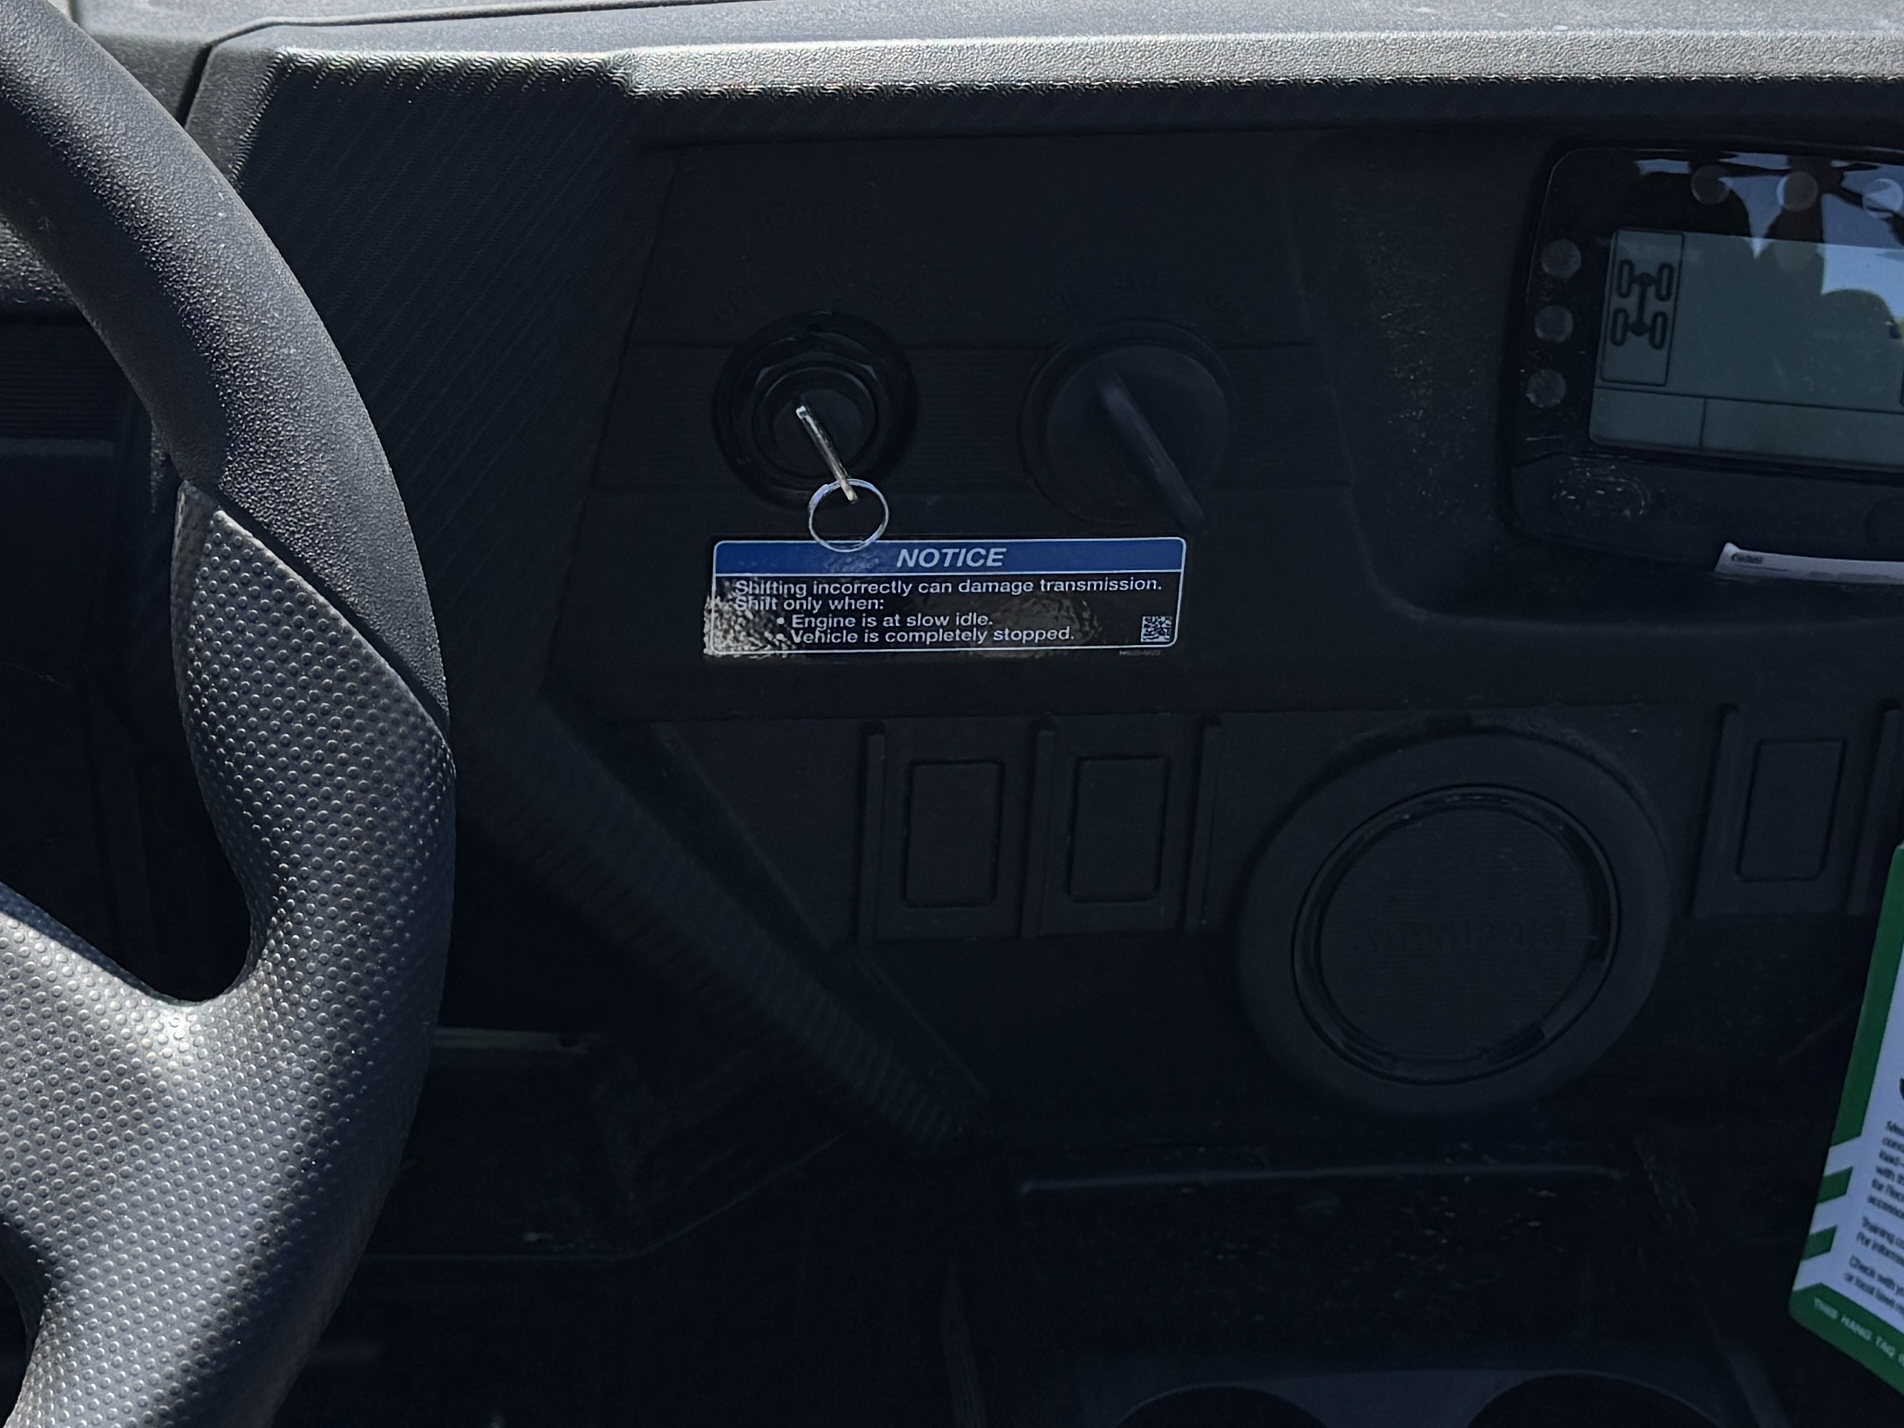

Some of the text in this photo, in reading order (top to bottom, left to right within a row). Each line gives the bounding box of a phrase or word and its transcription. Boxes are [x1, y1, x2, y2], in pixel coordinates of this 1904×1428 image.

[896, 547, 1007, 568] NOTICE
[735, 576, 1162, 598] Shifting incorrectly can damage transmission.
[735, 595, 884, 613] Shift only when:
[791, 612, 993, 631] Engine is at slow idle.
[791, 626, 1074, 645] Vehicle is completely stopped.
